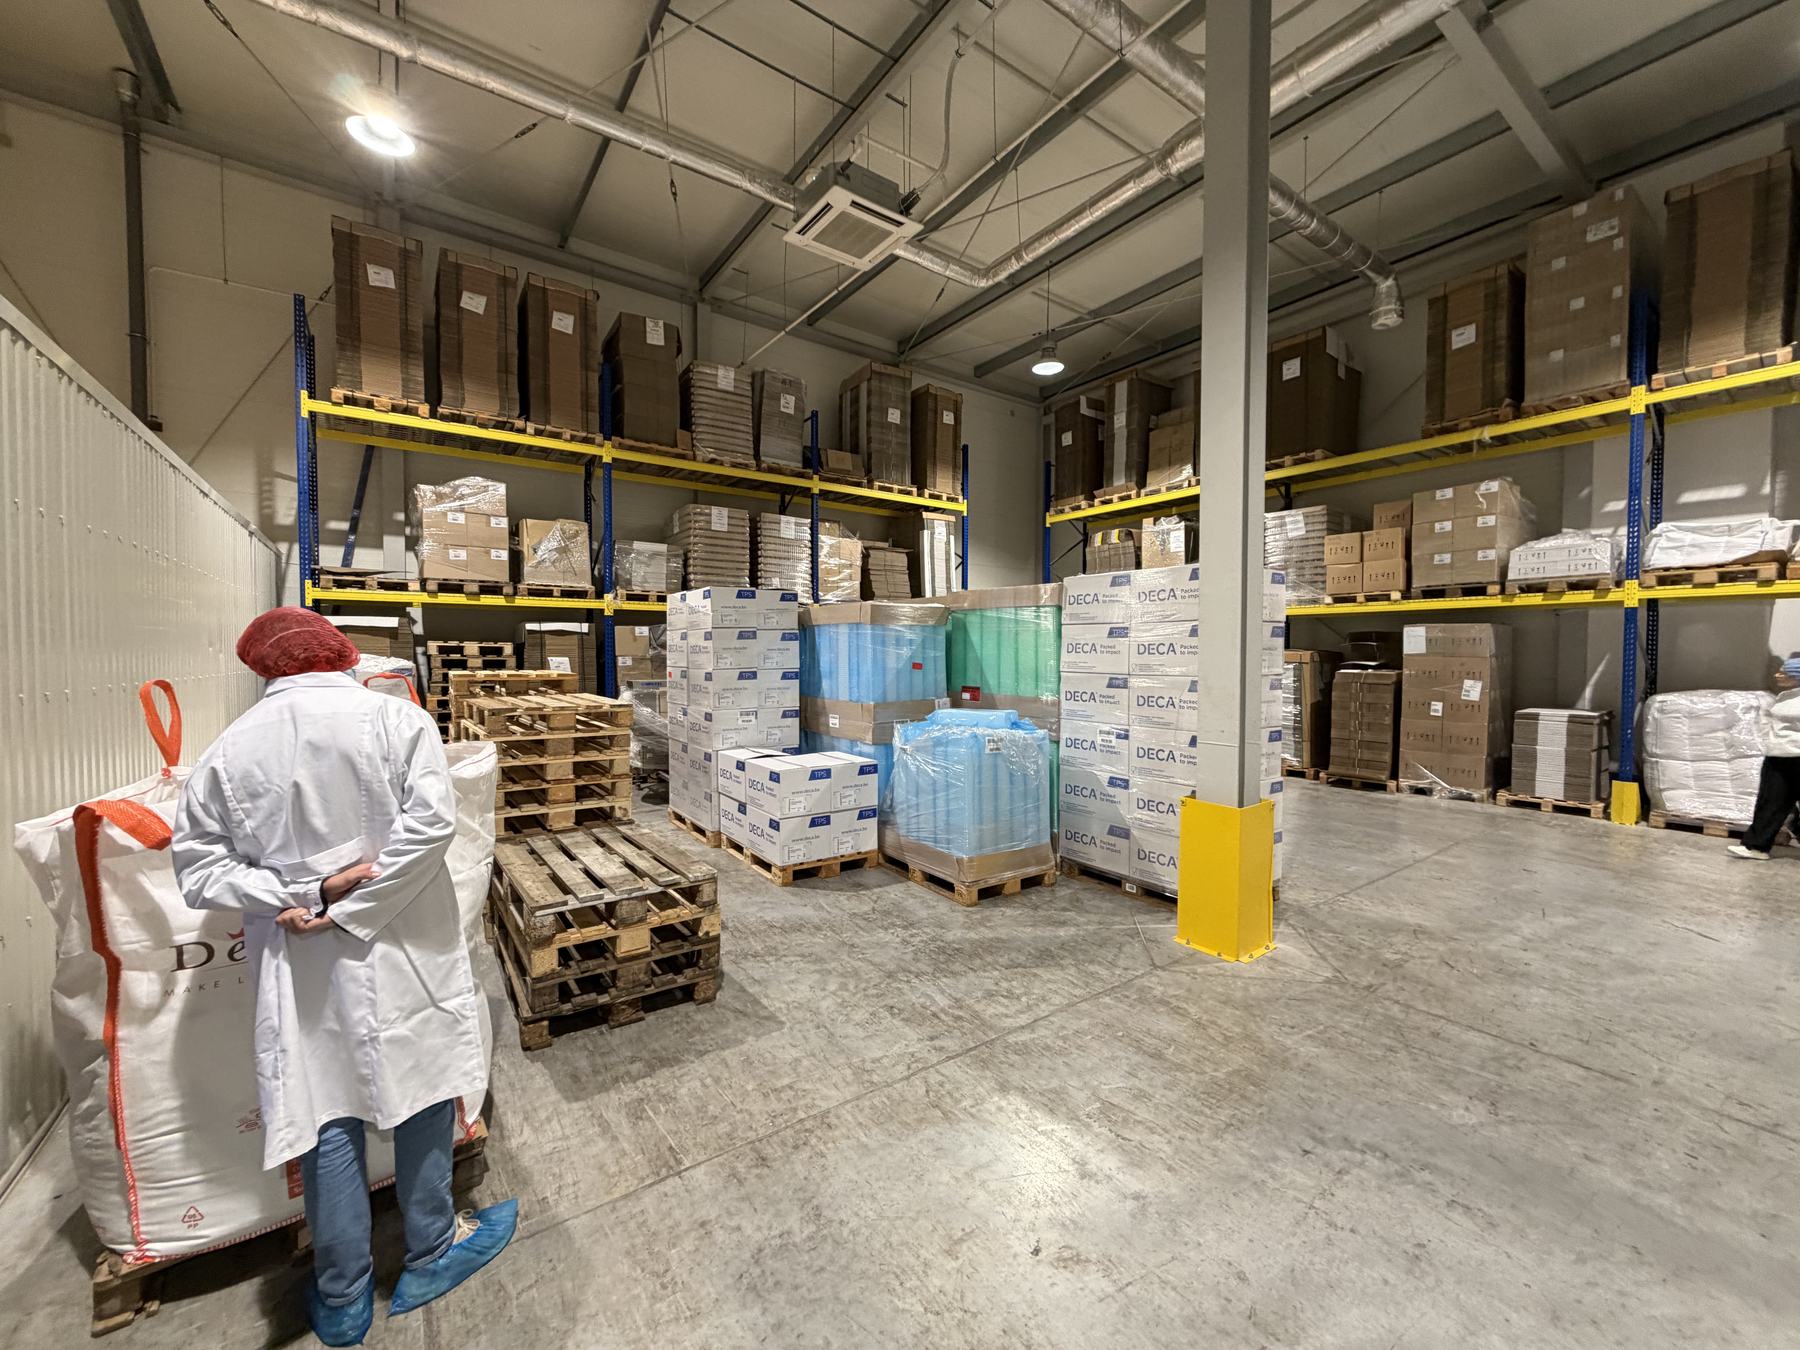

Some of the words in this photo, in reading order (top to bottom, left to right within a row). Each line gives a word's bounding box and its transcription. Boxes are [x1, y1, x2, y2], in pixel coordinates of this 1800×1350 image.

[1068, 593, 1100, 605] DECA
[1138, 588, 1177, 603] DECA
[1066, 643, 1098, 654] DECA
[1137, 643, 1176, 655] DECA
[1065, 690, 1096, 703] DECA
[1137, 695, 1176, 709] DECA
[1065, 737, 1097, 752] DECA
[1137, 747, 1176, 763] DECA
[720, 768, 732, 781] DECA
[749, 778, 765, 794] DECA
[1065, 784, 1097, 800] DECA
[1137, 798, 1176, 816] DECA
[722, 808, 734, 823] DECA
[749, 822, 765, 839] DECA
[1065, 829, 1097, 848] DECA
[1137, 848, 1177, 869] DECA
[163, 981, 220, 998] MAKE
